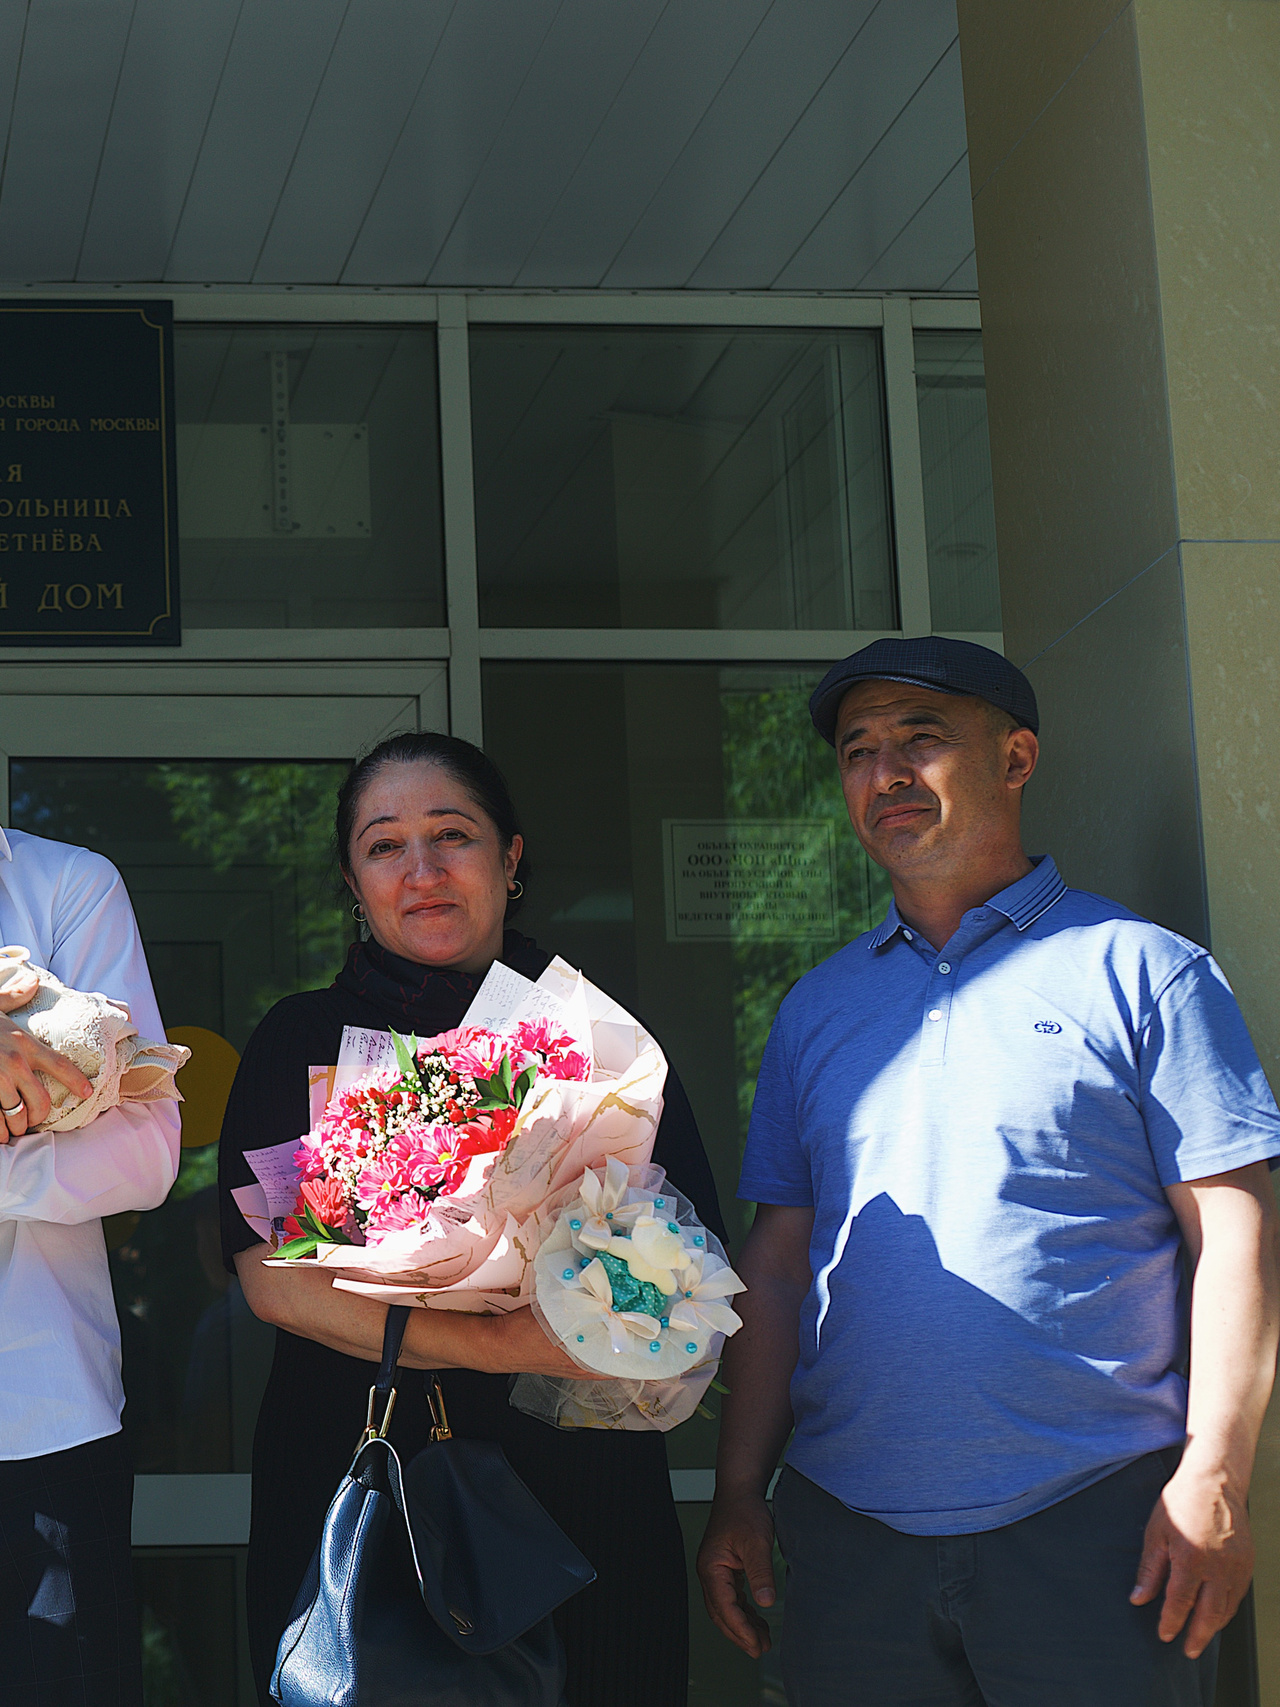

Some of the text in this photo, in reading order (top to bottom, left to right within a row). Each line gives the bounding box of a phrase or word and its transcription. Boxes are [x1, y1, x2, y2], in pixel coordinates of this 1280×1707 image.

[15, 417, 81, 433] ГОРОДА
[89, 417, 161, 432] МОСКВЫ
[37, 583, 124, 614] ДОМ
[687, 854, 722, 866] ООО
